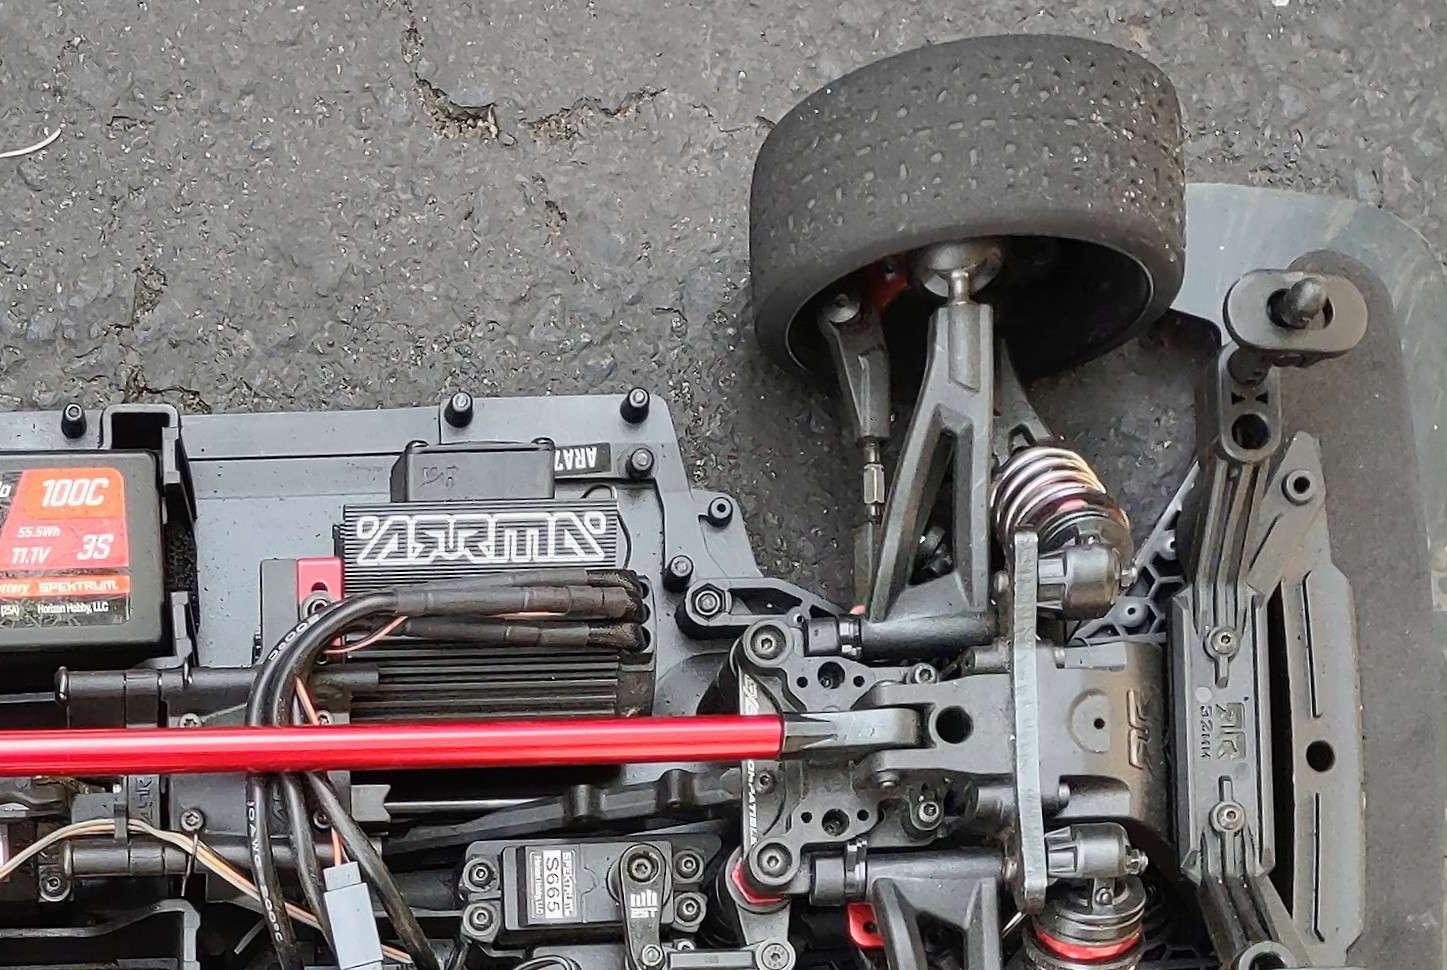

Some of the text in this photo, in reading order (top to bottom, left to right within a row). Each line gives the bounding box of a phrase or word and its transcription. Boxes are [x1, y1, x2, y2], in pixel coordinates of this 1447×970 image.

[42, 478, 109, 507] 100C
[17, 526, 61, 538] 55.5Wh
[77, 533, 114, 560] 3S
[12, 547, 52, 564] 11.1V
[39, 580, 118, 592] SPEKTRUM
[38, 601, 109, 615] Horizon Hobby, LLC
[546, 857, 560, 912] S665
